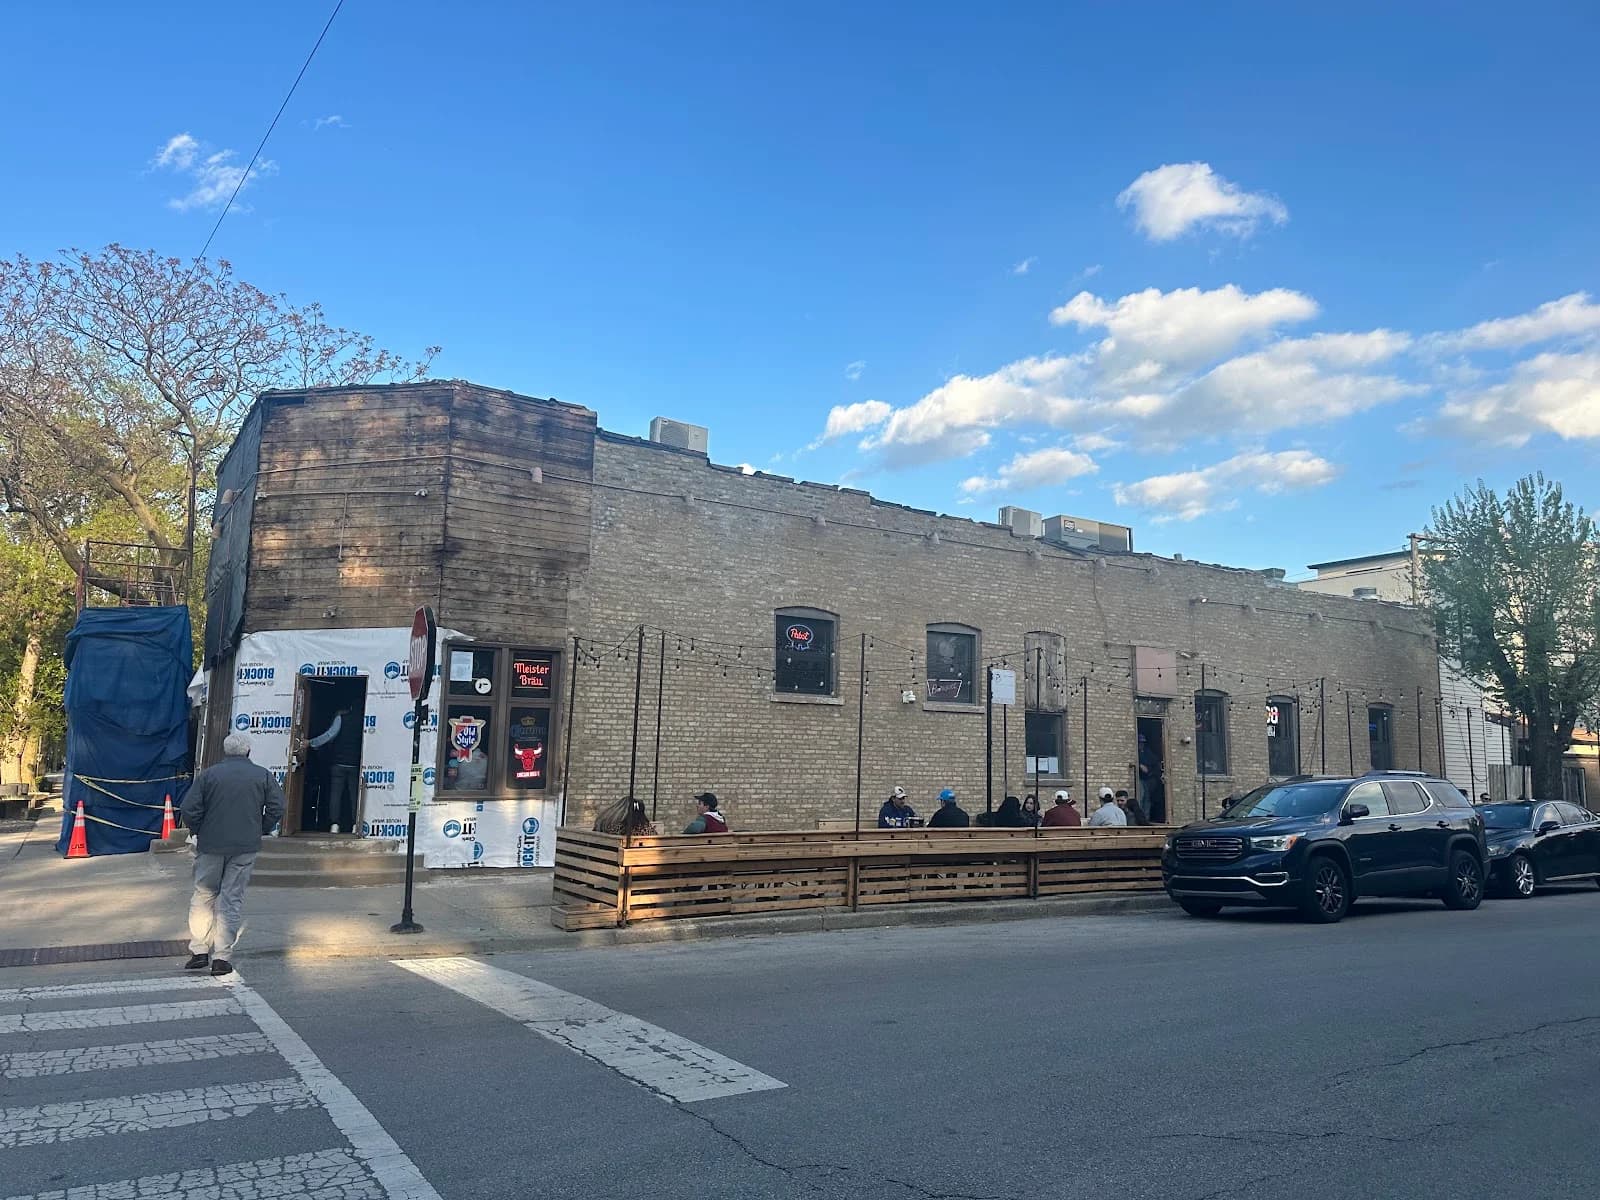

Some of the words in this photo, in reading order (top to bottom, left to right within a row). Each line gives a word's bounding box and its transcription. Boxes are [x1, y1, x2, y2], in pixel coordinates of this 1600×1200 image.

[790, 628, 810, 641] Pabst
[409, 635, 428, 672] STOP
[513, 662, 550, 674] Meister
[463, 727, 476, 736] Old
[456, 733, 476, 748] Style
[1192, 839, 1217, 848] GMC
